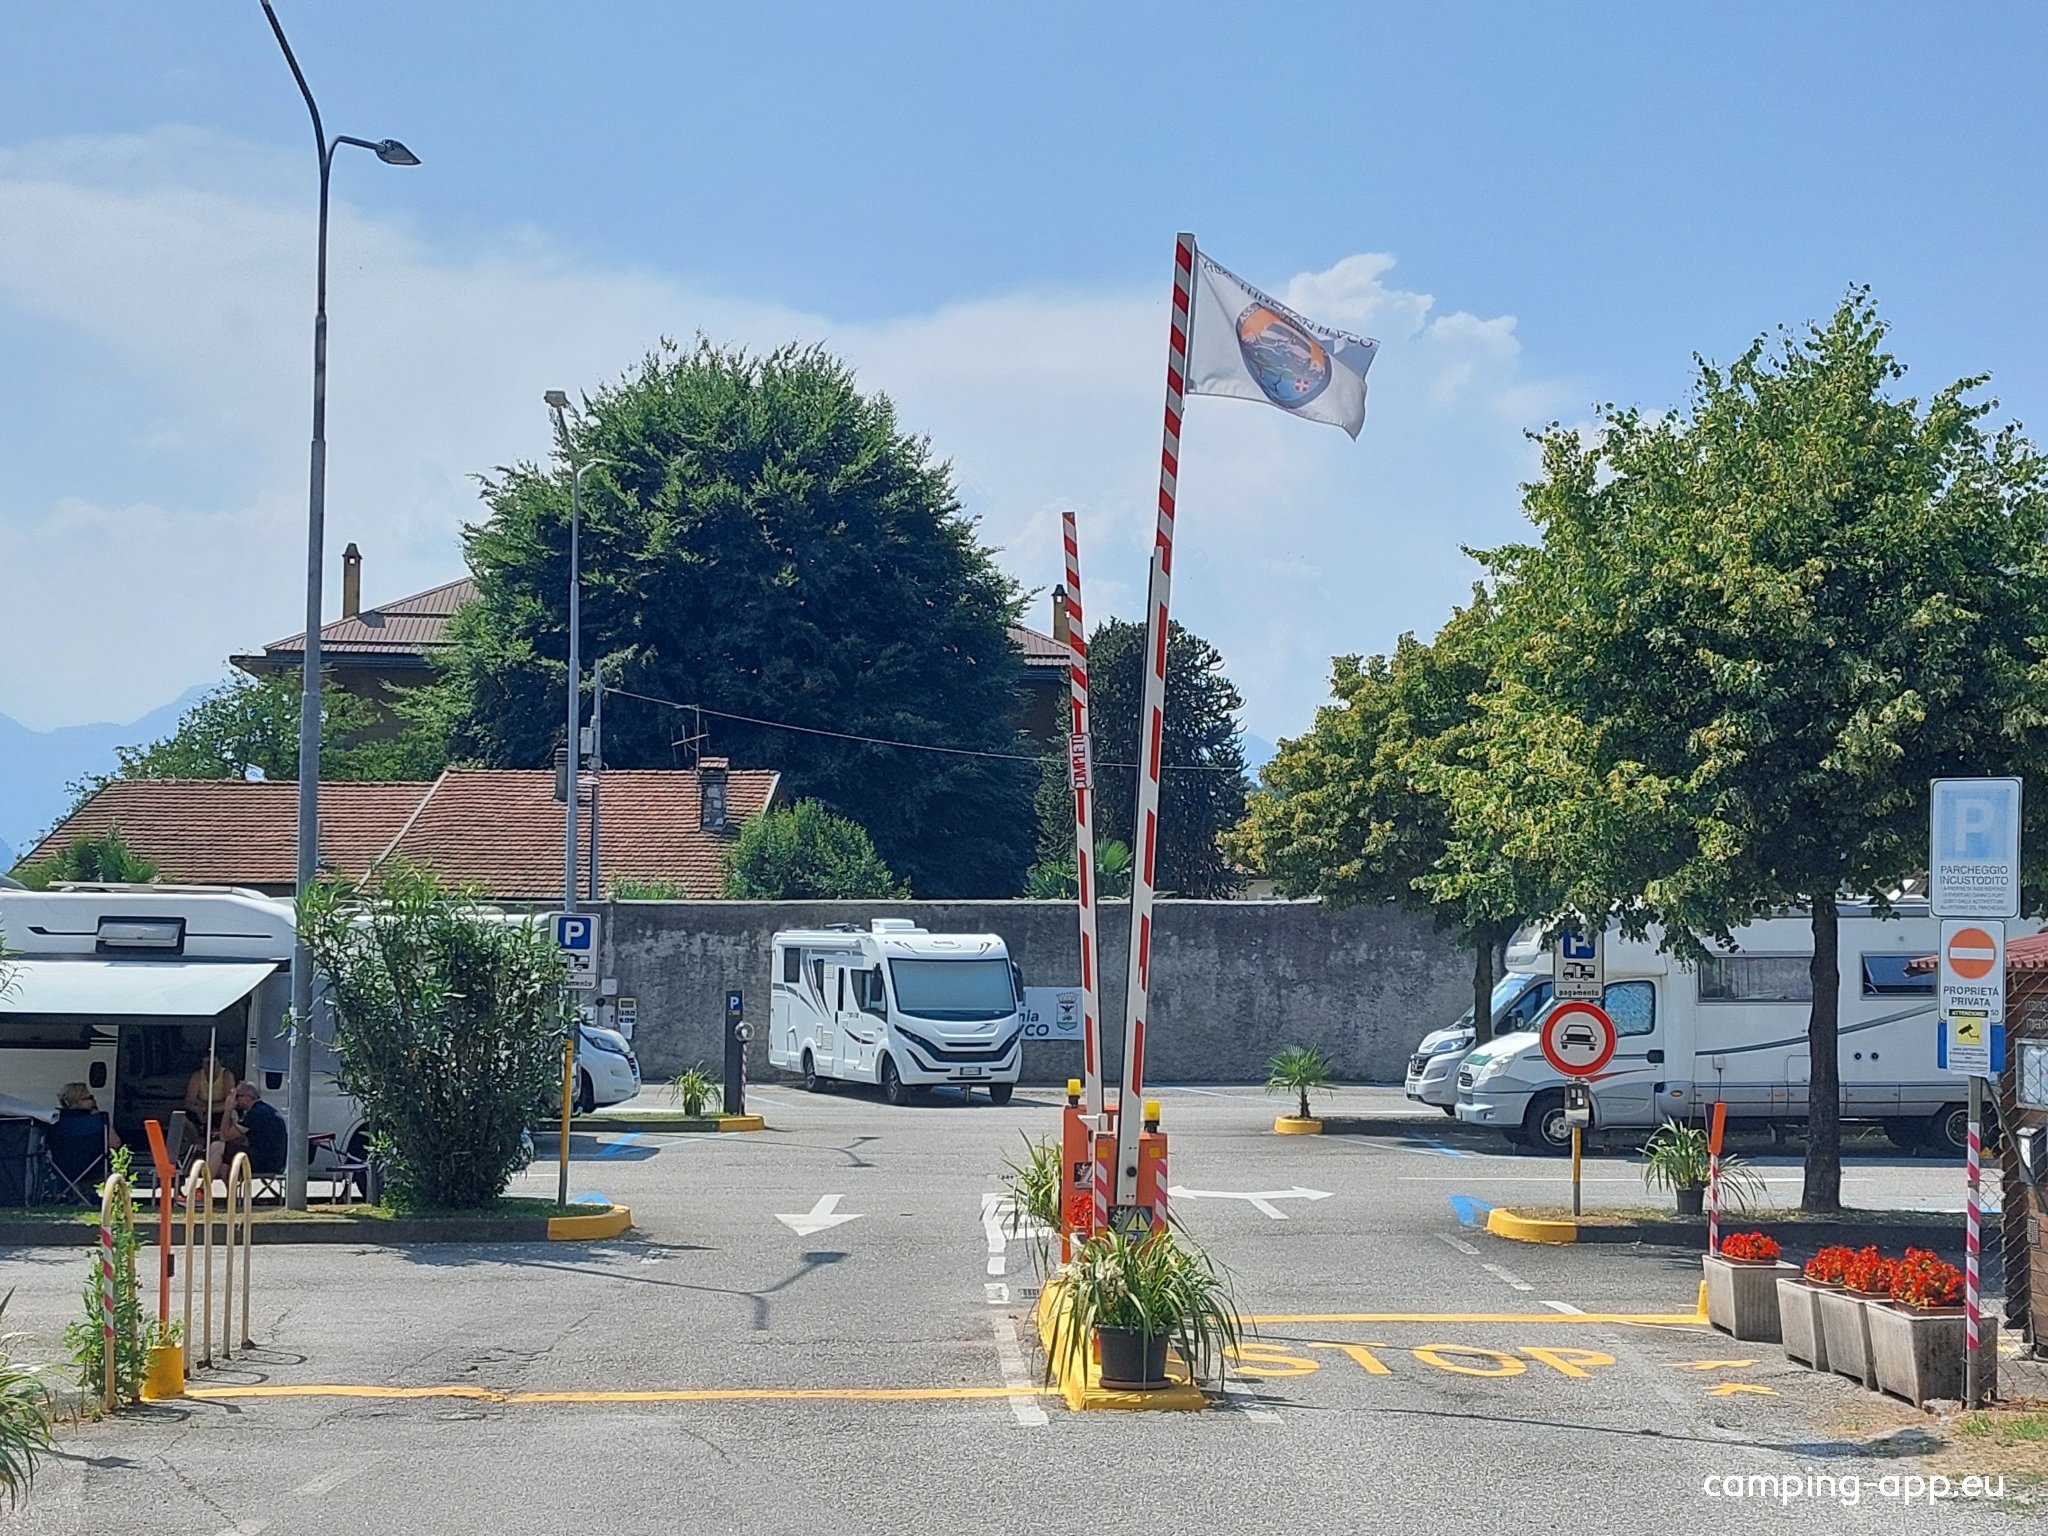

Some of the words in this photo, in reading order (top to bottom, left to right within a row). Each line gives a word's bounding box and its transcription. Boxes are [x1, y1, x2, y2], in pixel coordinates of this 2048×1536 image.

[1955, 799, 1994, 852] P
[1940, 865, 2008, 875] PARCHEGGIO
[1940, 876, 2009, 885] INCUSTODITO
[564, 921, 585, 945] P
[1559, 990, 1599, 998] pagamento
[730, 996, 739, 1009] P
[1951, 996, 1991, 1007] PRIVATA
[1224, 1342, 1617, 1378] STOP
